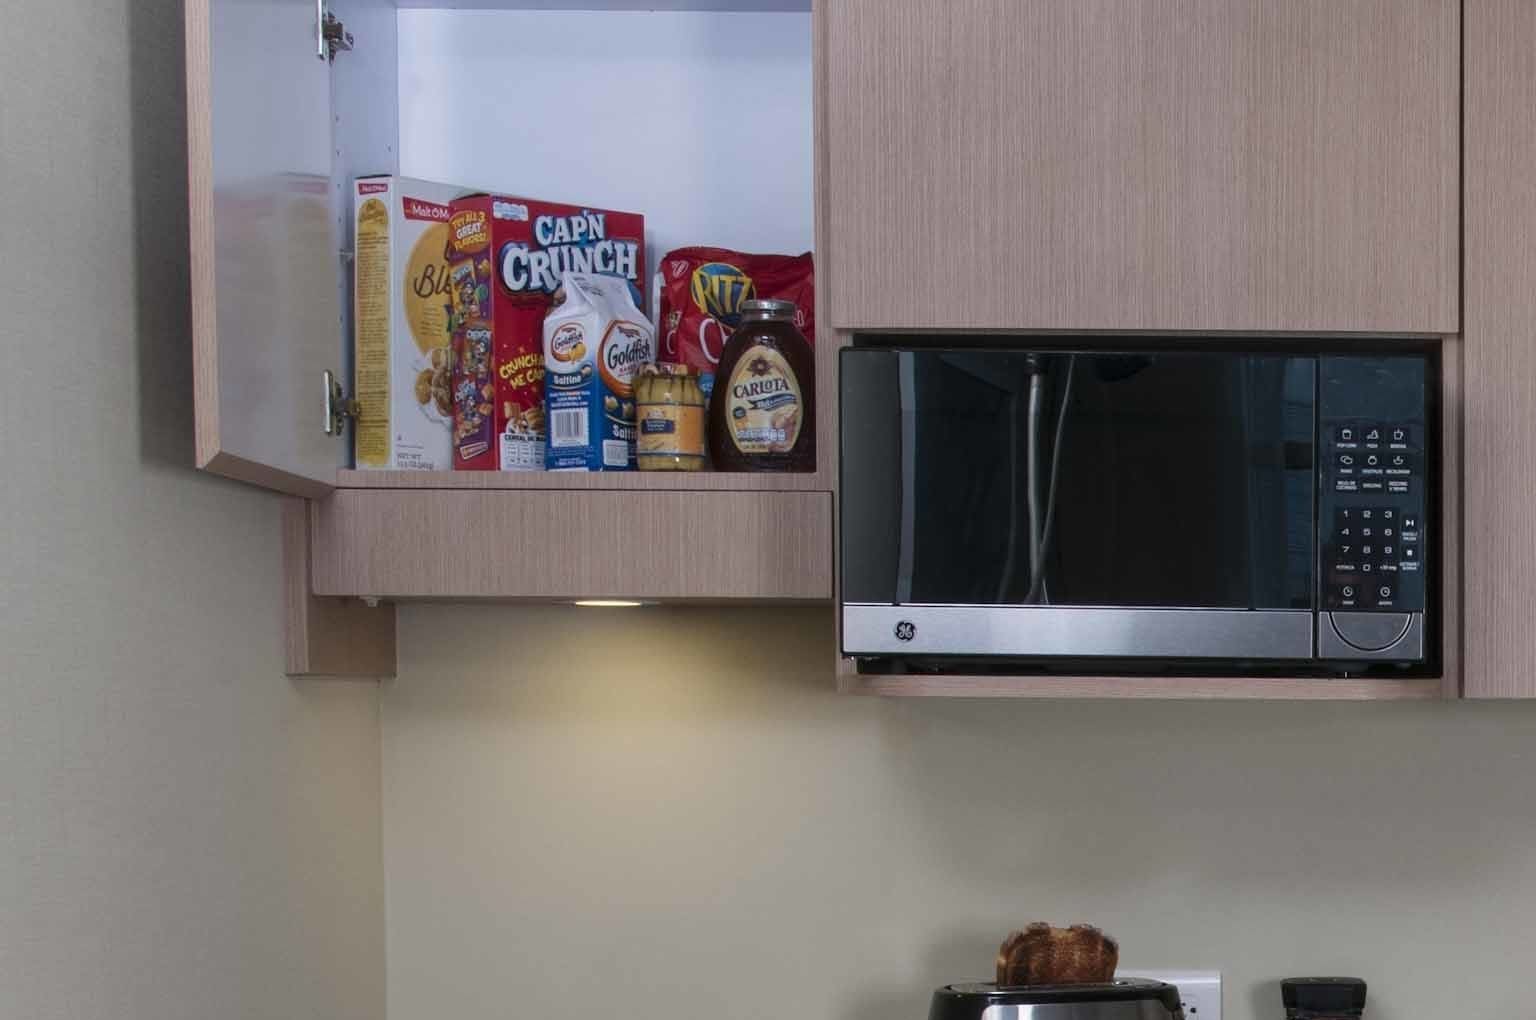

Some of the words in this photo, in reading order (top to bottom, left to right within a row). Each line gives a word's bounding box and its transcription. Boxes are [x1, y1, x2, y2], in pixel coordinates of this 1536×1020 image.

[456, 222, 481, 240] GREAT
[534, 208, 606, 247] CAP'N
[503, 240, 638, 292] CRUNCH
[693, 271, 752, 316] RITZ
[608, 339, 651, 369] Goldfish
[734, 379, 789, 399] CARLOTA
[1344, 510, 1349, 518] 1
